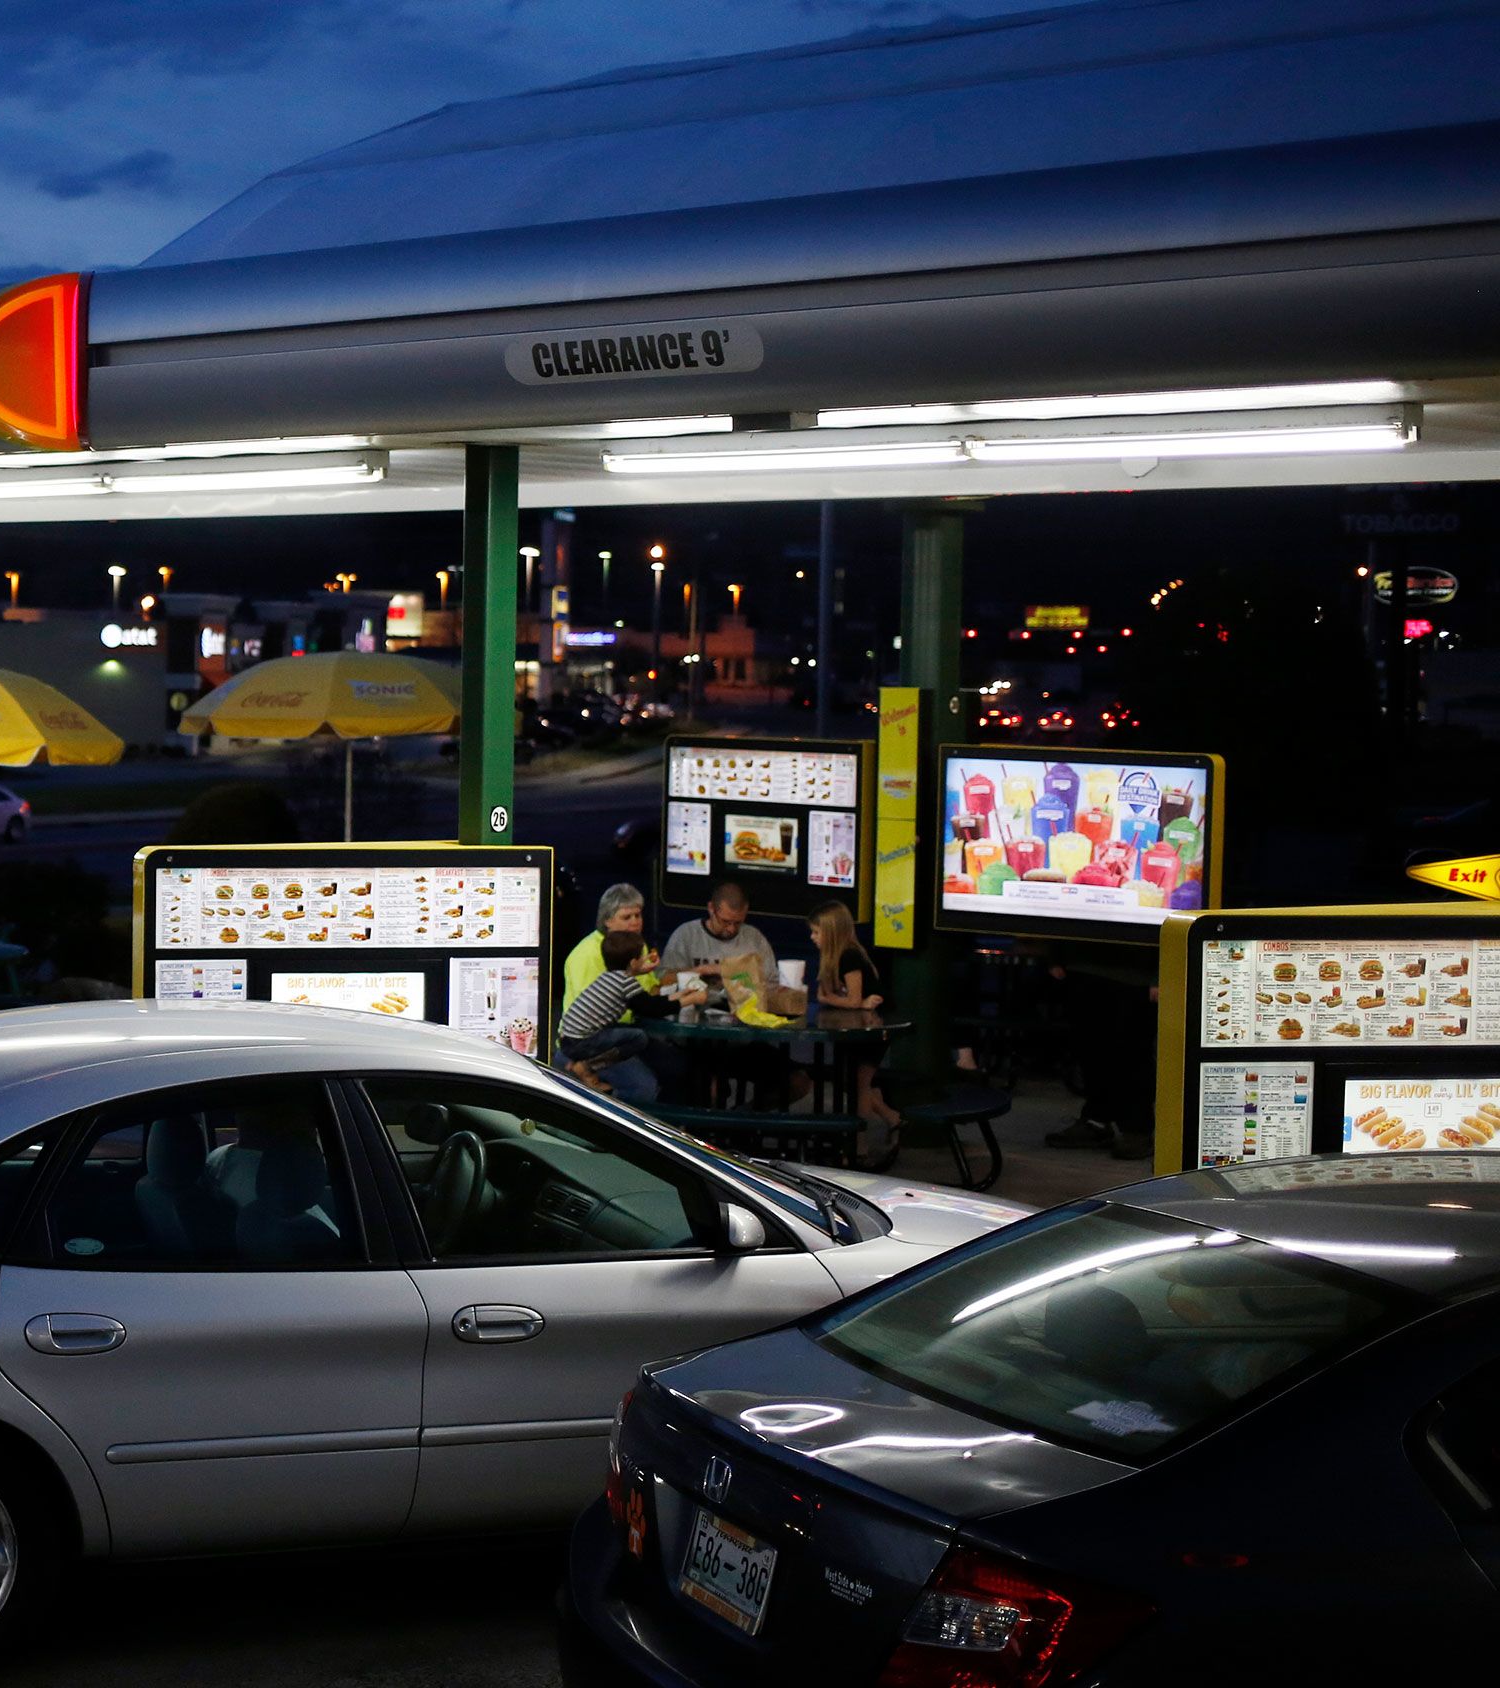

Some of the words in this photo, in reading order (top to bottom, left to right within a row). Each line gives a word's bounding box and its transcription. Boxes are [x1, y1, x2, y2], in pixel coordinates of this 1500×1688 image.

[532, 332, 699, 378] CLEARANCE
[1342, 513, 1460, 533] TOBACCO
[354, 684, 415, 696] SONIC
[492, 811, 506, 828] 26
[1448, 868, 1488, 883] Exit
[1263, 942, 1290, 952] COMBOS
[287, 978, 305, 989] BIG
[307, 977, 346, 989] FLAVOR
[384, 977, 408, 988] BITE
[1360, 1084, 1382, 1099] BIG
[1384, 1082, 1433, 1099] FLAVOR
[856, 1579, 873, 1598] Honda
